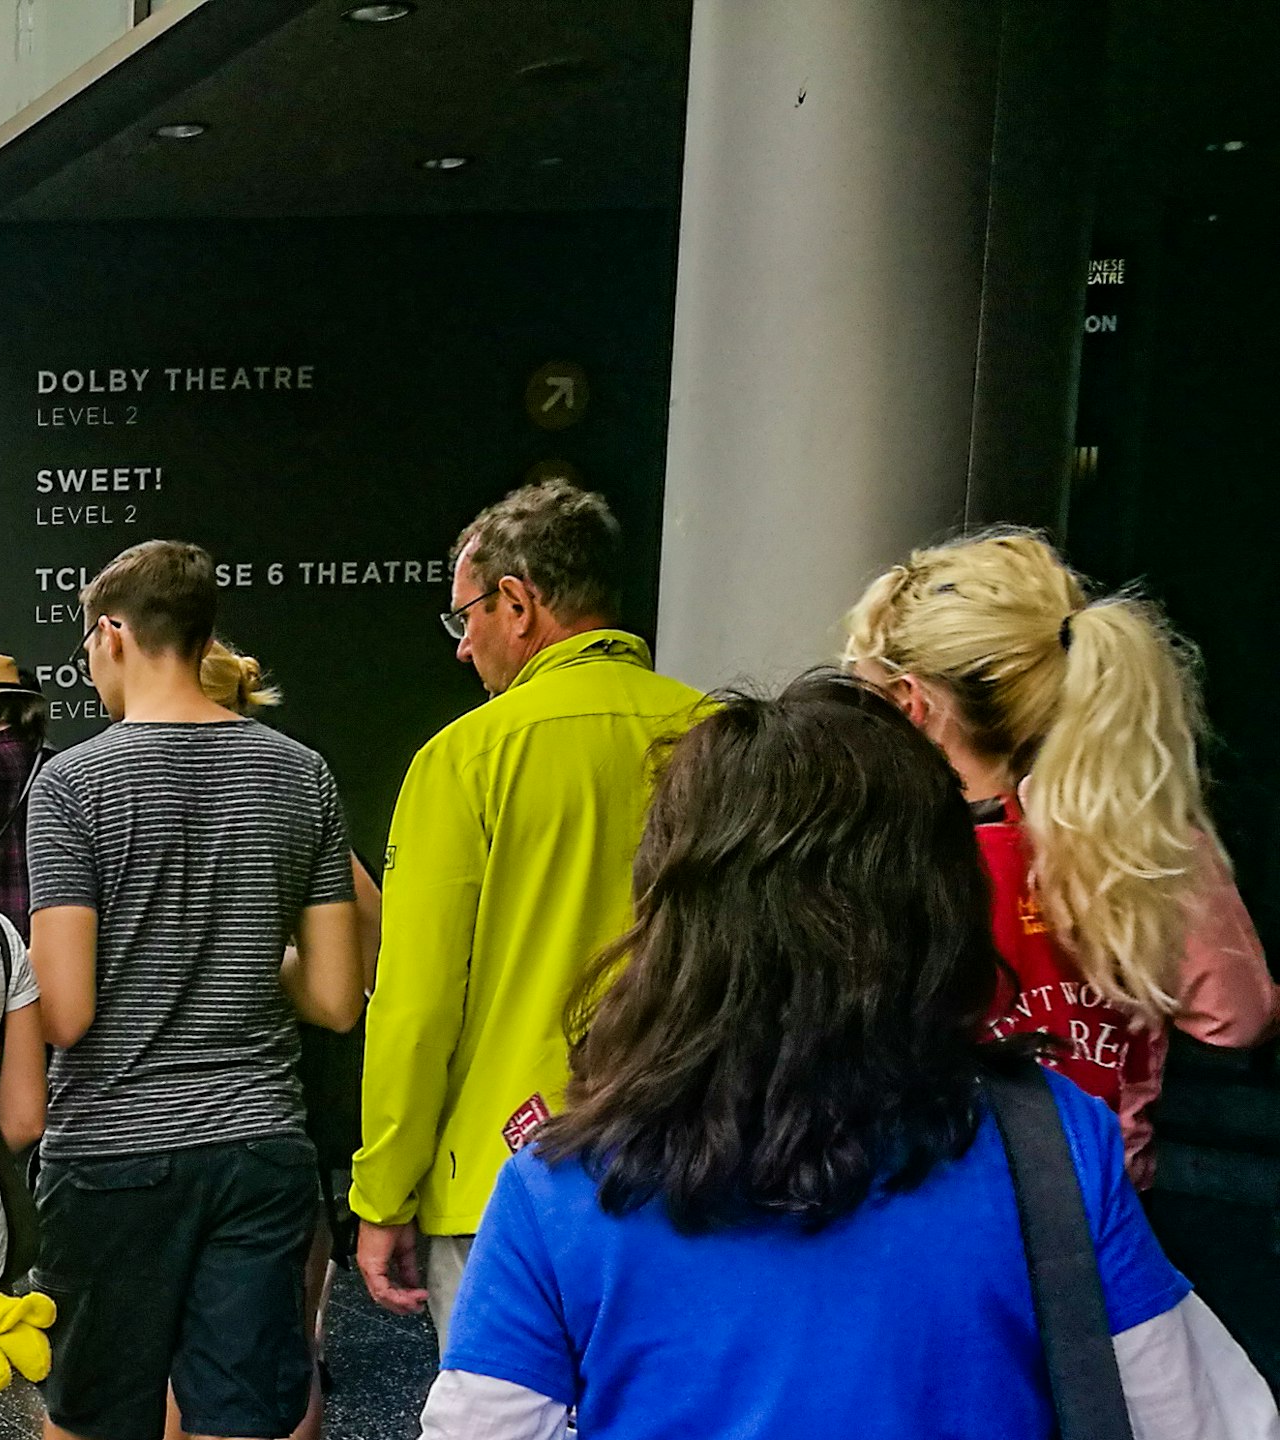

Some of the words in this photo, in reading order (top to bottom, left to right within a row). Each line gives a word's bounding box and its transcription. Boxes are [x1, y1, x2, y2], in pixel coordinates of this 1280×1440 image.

[1089, 259, 1125, 271] INESE
[1088, 272, 1124, 285] EATRE
[38, 369, 150, 393] DOLBY
[165, 366, 314, 391] THEATRE
[37, 407, 114, 426] LEVEL
[126, 406, 138, 425] 2
[37, 468, 163, 493] SWEET!
[36, 506, 113, 525] LEVEL
[125, 505, 137, 524] 2
[268, 563, 284, 585] 6
[50, 700, 111, 720] EVEL
